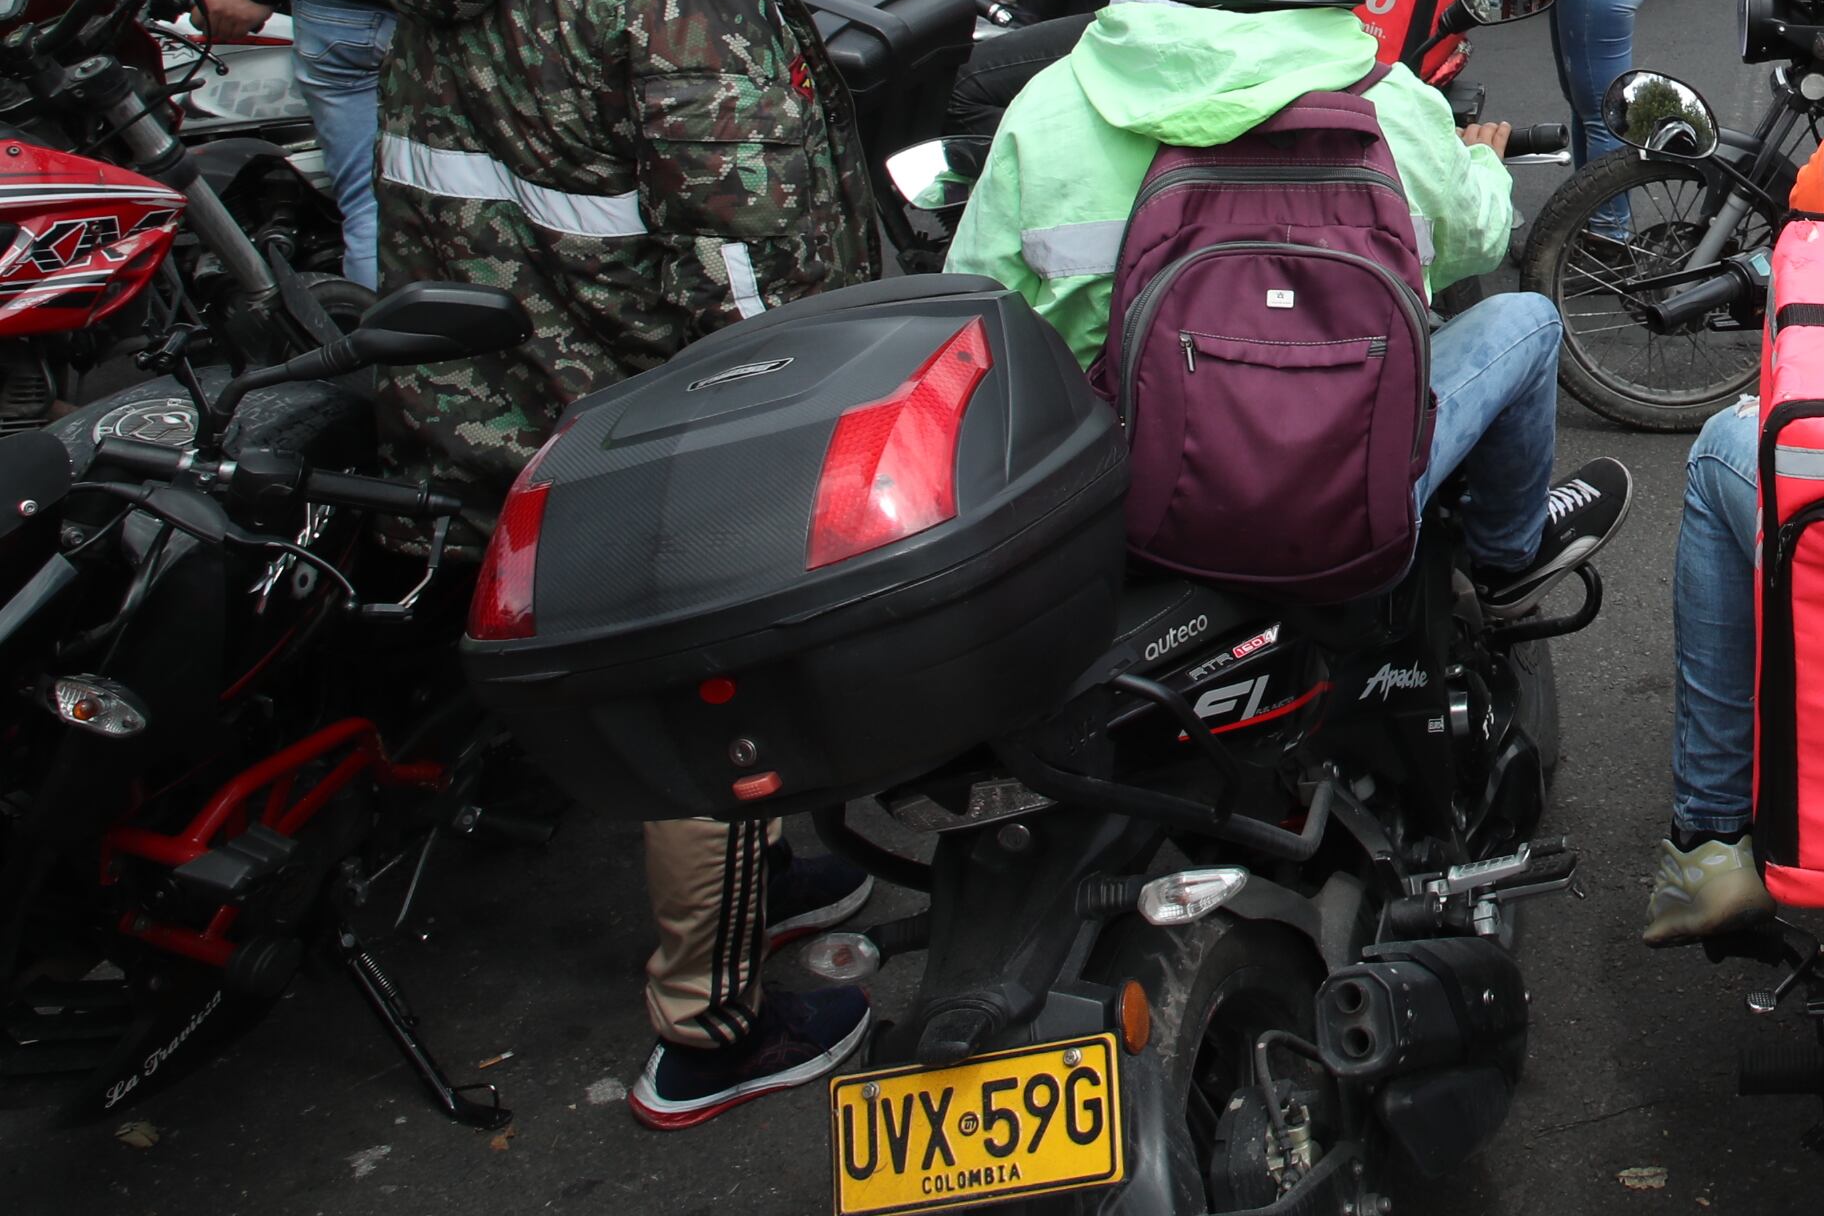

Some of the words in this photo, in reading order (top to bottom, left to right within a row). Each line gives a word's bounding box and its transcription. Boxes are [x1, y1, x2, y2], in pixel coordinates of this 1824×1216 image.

[1145, 614, 1208, 661] auteco
[1188, 652, 1233, 681] RTR
[1359, 659, 1428, 702] Apache
[104, 1074, 139, 1109] La
[843, 1087, 955, 1181] UVX
[982, 1066, 1104, 1158] 59G
[922, 1162, 1022, 1195] COLOMBIA
